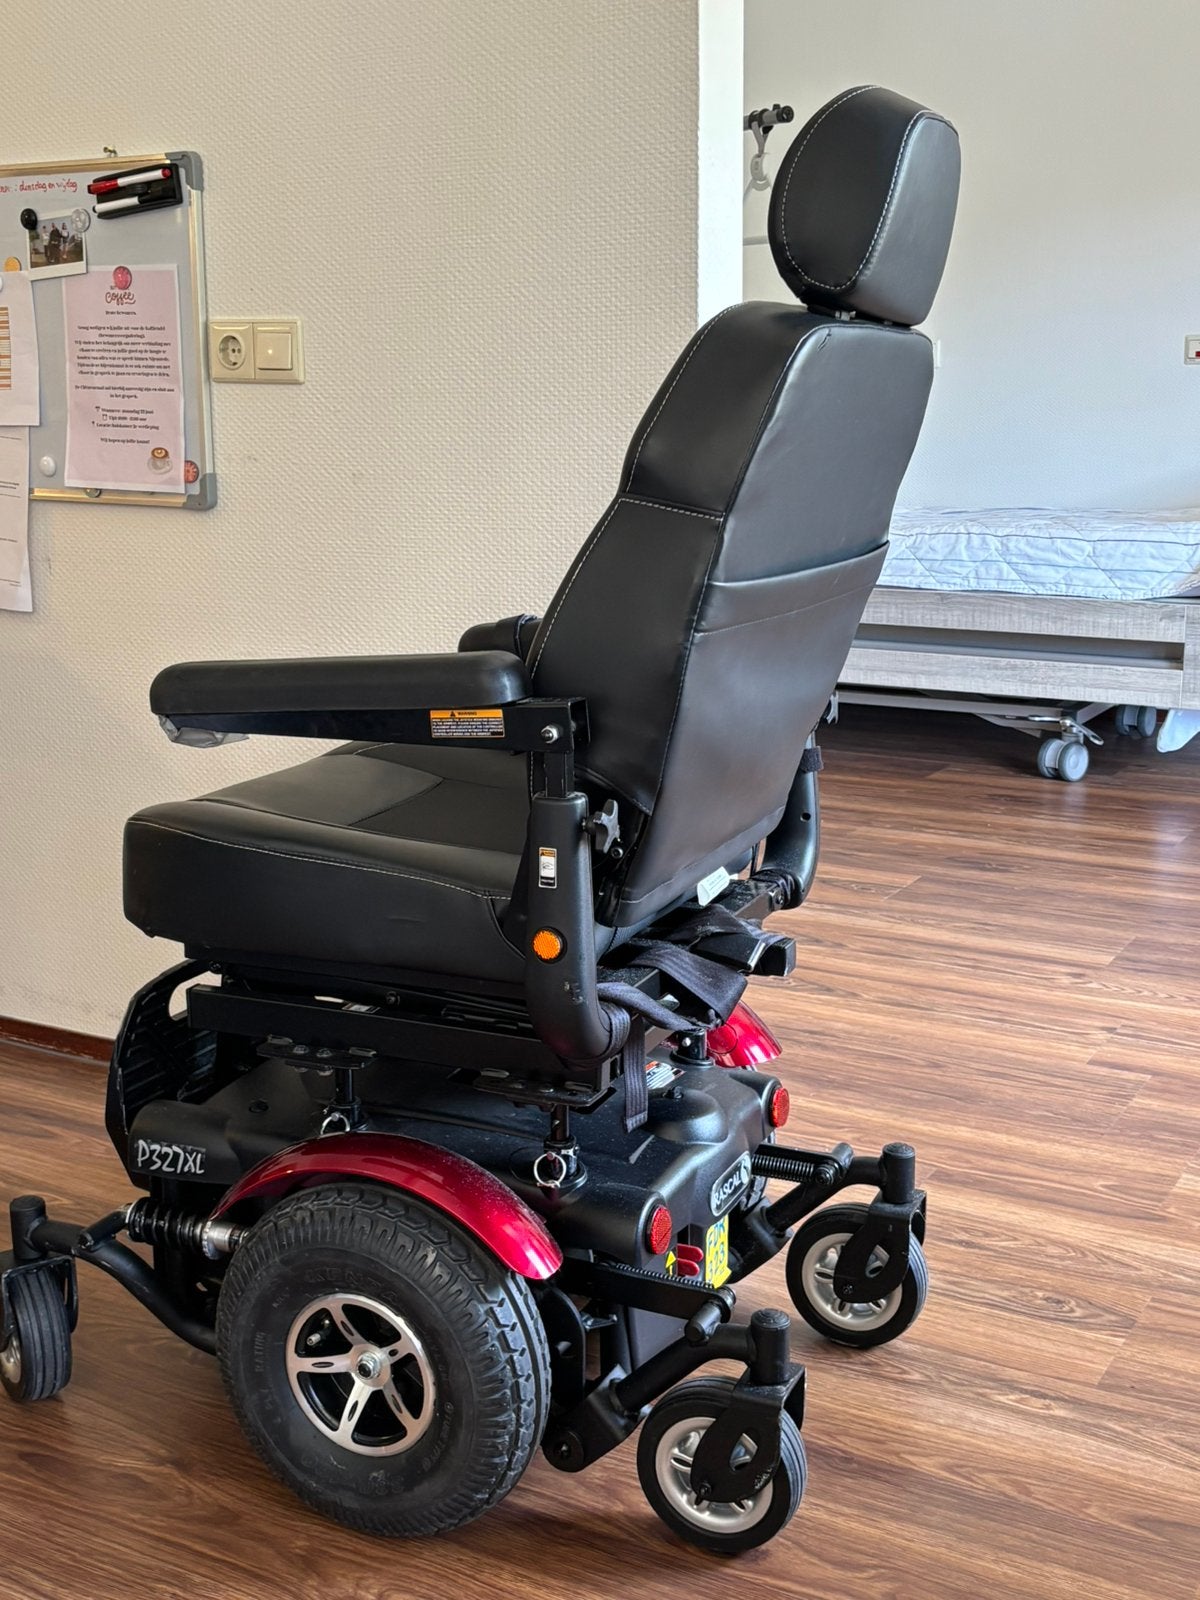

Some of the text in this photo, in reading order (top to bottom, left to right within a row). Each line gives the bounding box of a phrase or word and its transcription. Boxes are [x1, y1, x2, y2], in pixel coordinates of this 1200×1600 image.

[105, 291, 137, 306] Coffee
[137, 1139, 205, 1174] P327XL
[714, 1170, 742, 1206] RASCAL
